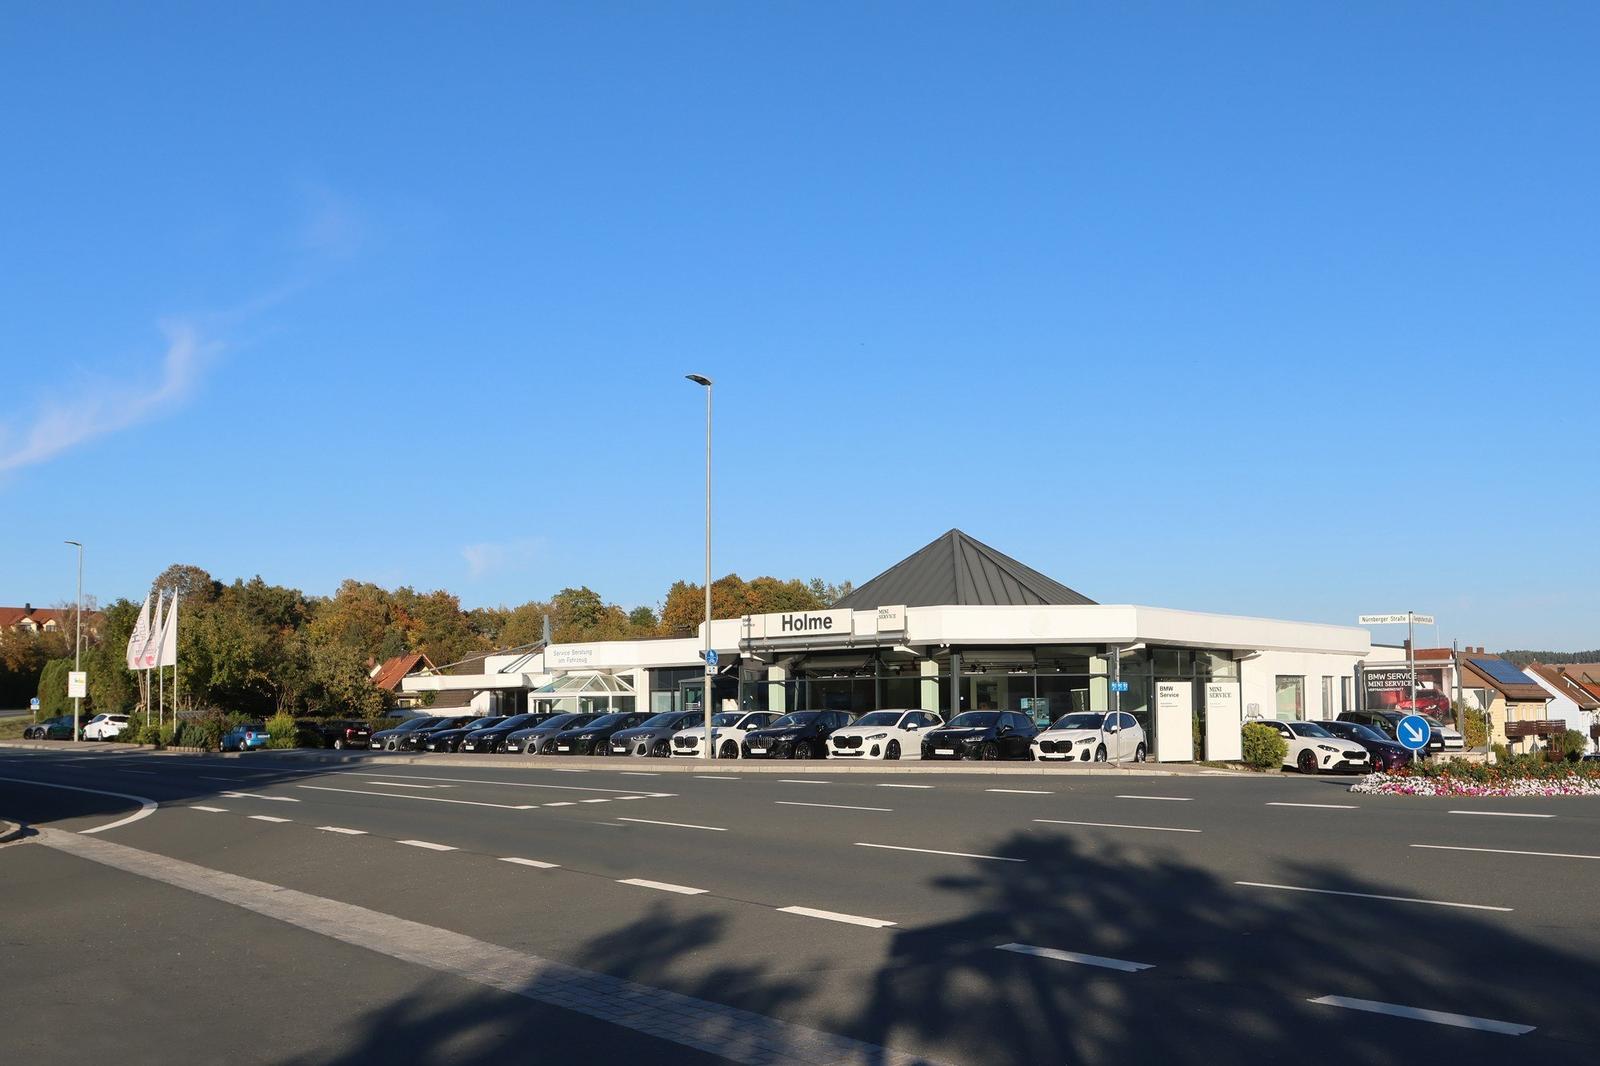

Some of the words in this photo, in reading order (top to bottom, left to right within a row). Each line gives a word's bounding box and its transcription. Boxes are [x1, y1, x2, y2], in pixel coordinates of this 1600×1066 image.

[782, 613, 833, 632] Holme
[1367, 673, 1386, 681] BMW
[1386, 672, 1418, 680] SERVICE
